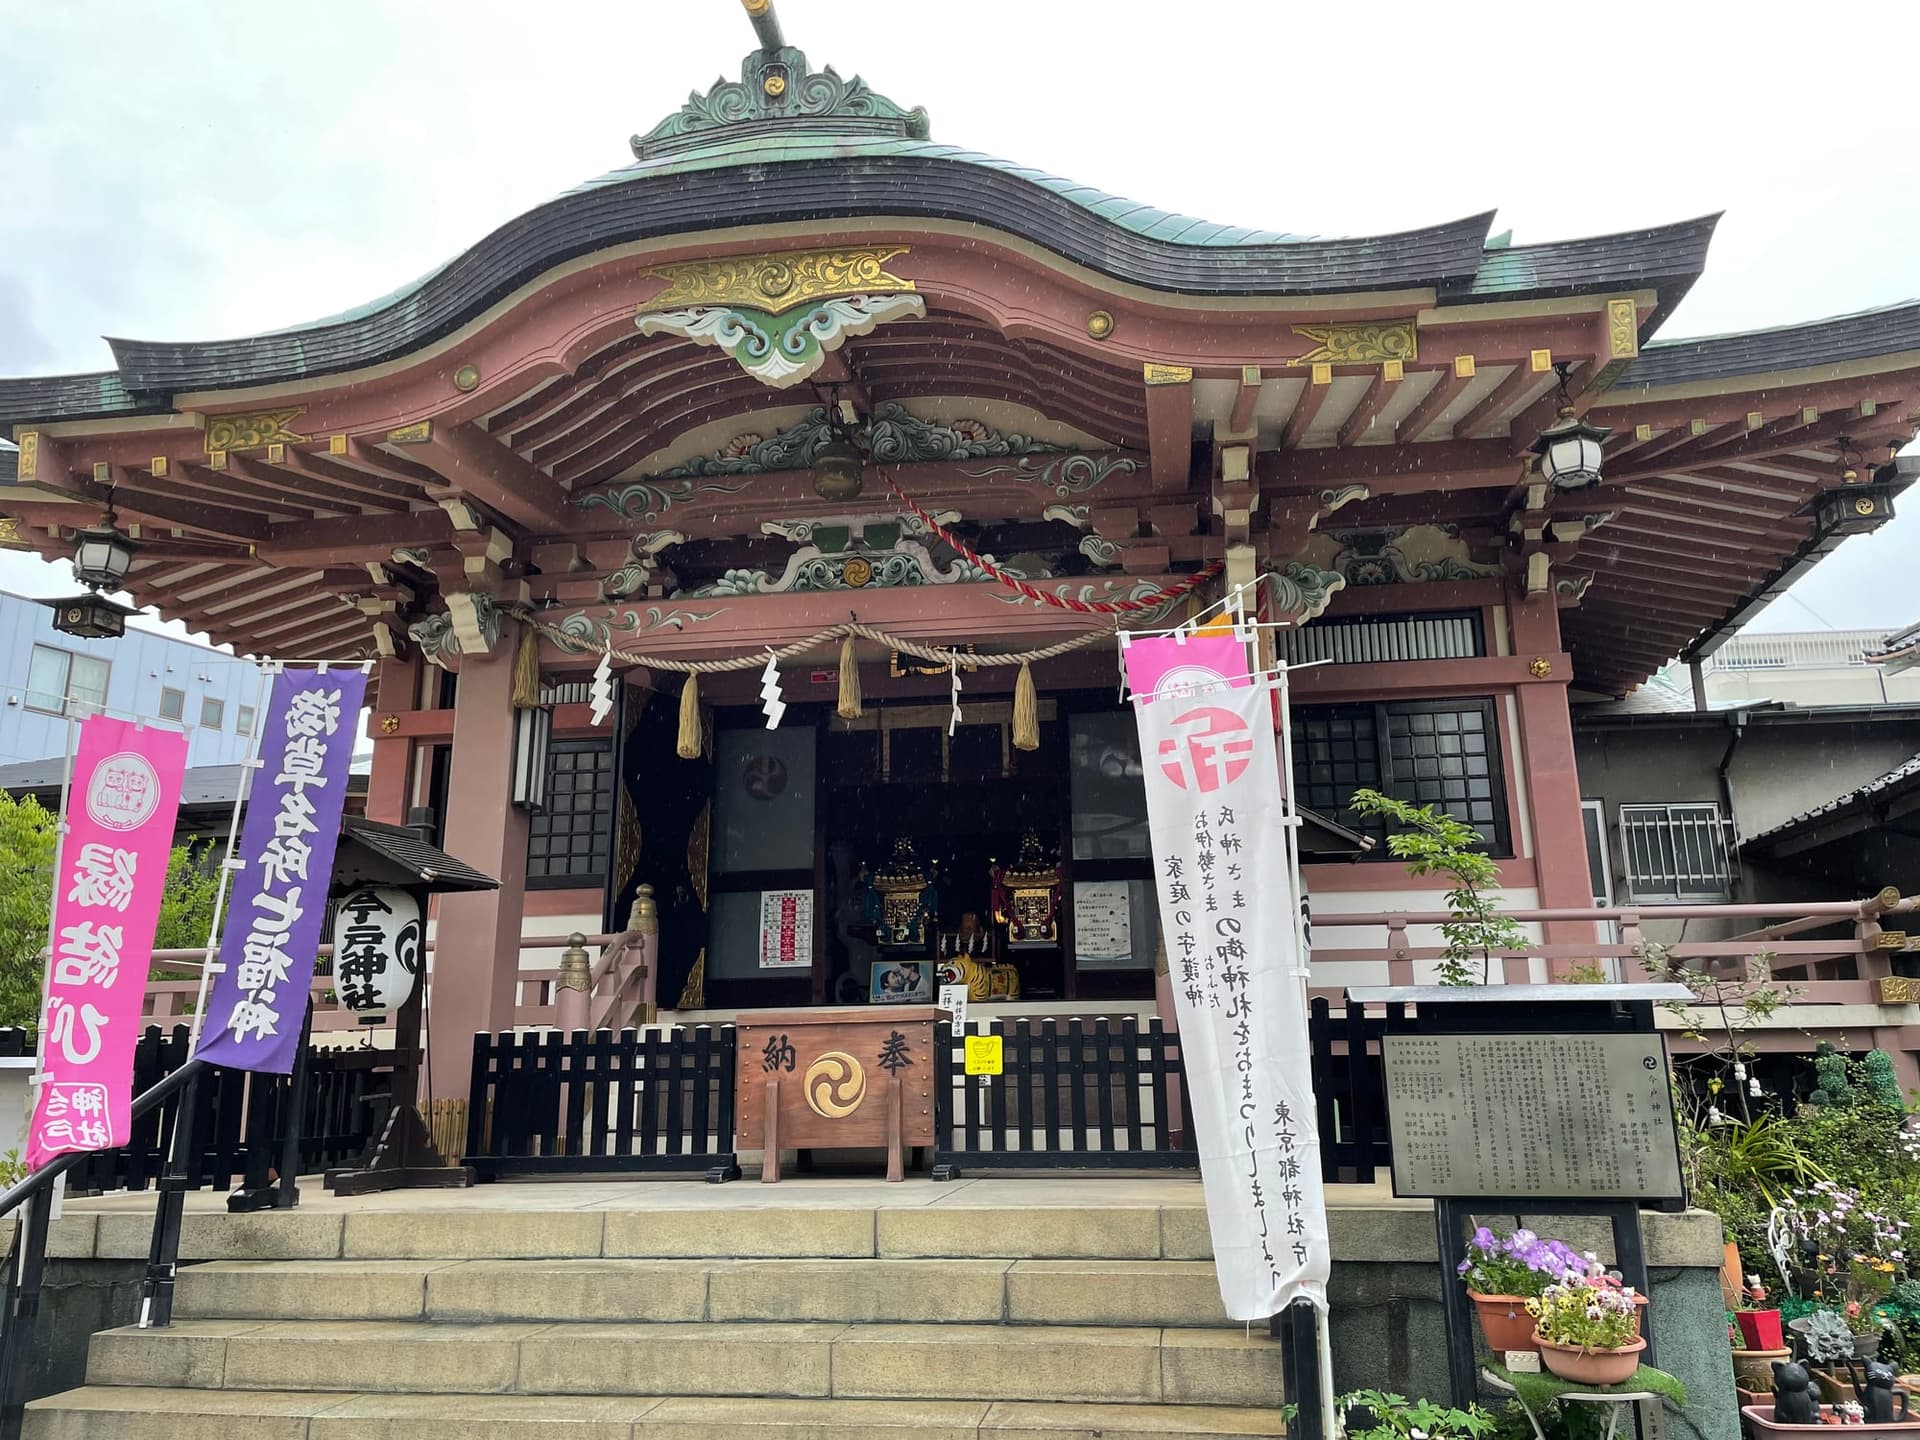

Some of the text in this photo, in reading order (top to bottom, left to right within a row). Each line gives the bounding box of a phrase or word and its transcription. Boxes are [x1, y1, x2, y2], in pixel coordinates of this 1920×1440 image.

[340, 891, 392, 1011] 今戸神社
[1648, 1074, 1665, 1126] 今戸神社
